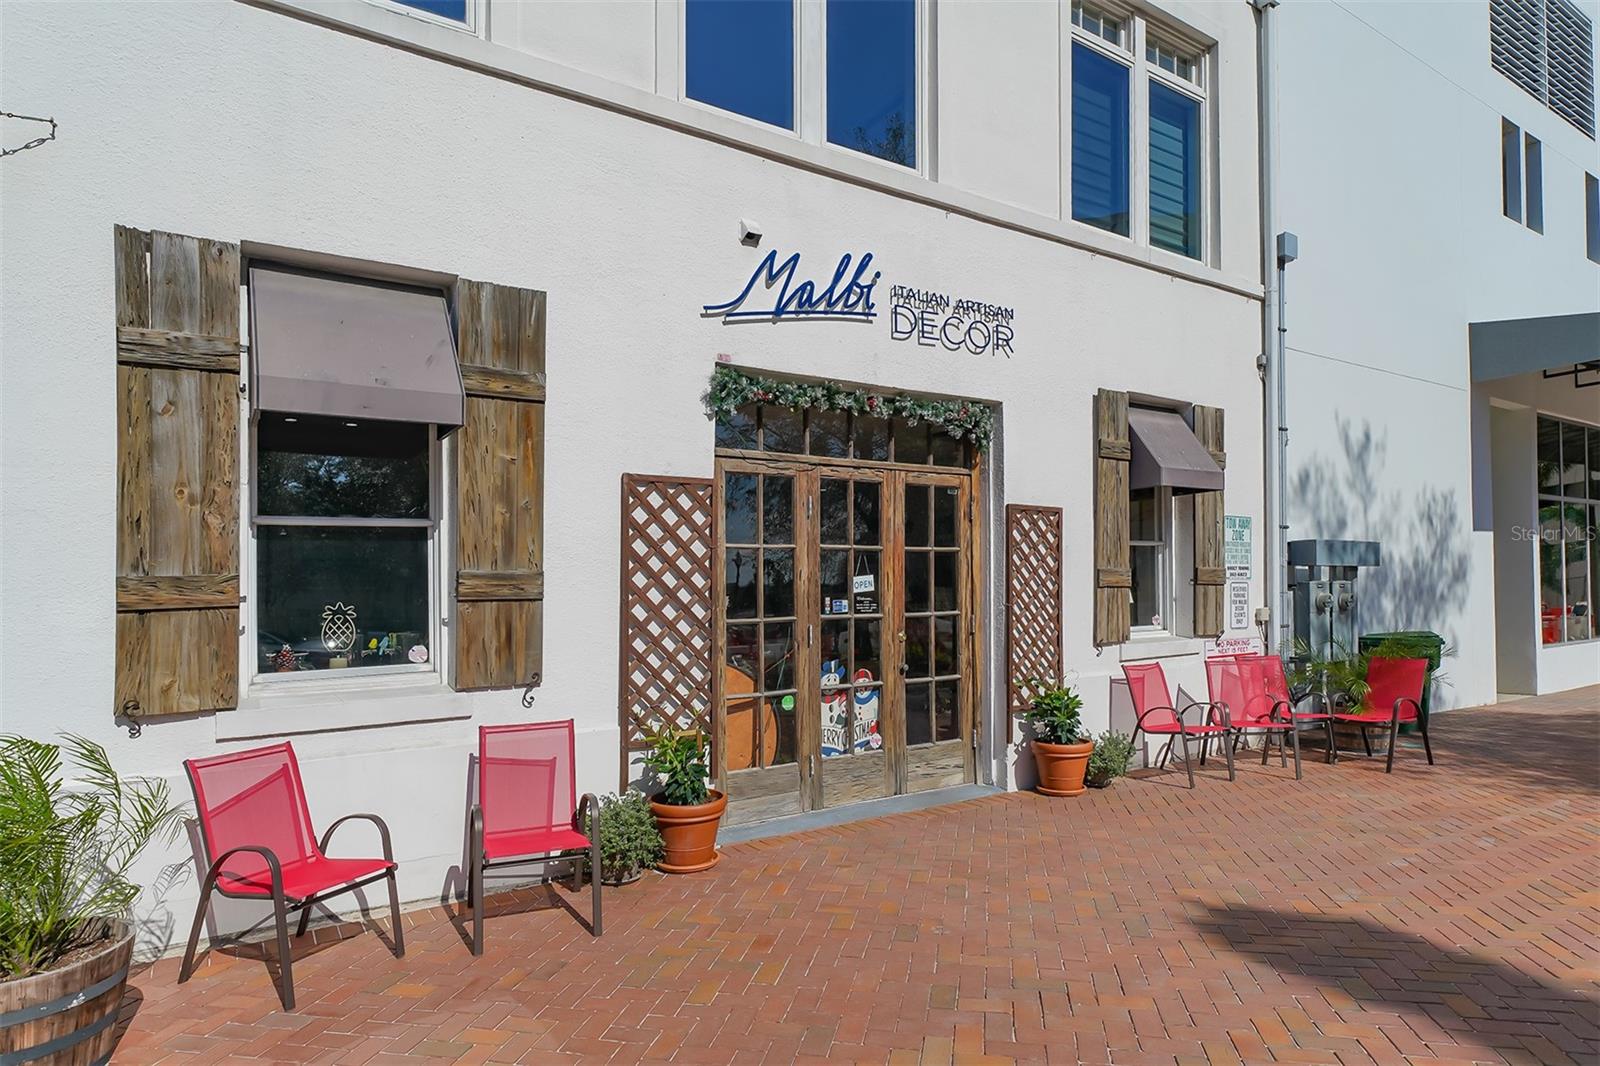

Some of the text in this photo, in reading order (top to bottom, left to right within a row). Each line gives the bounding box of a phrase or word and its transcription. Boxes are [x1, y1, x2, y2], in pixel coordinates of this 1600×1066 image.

[703, 249, 881, 318] Malbi
[893, 284, 1014, 320] ITALIAN ARTISAN
[894, 304, 1014, 354] DECOR
[1226, 517, 1237, 528] TOW
[1231, 529, 1244, 541] ZONE
[854, 580, 873, 589] OPEN
